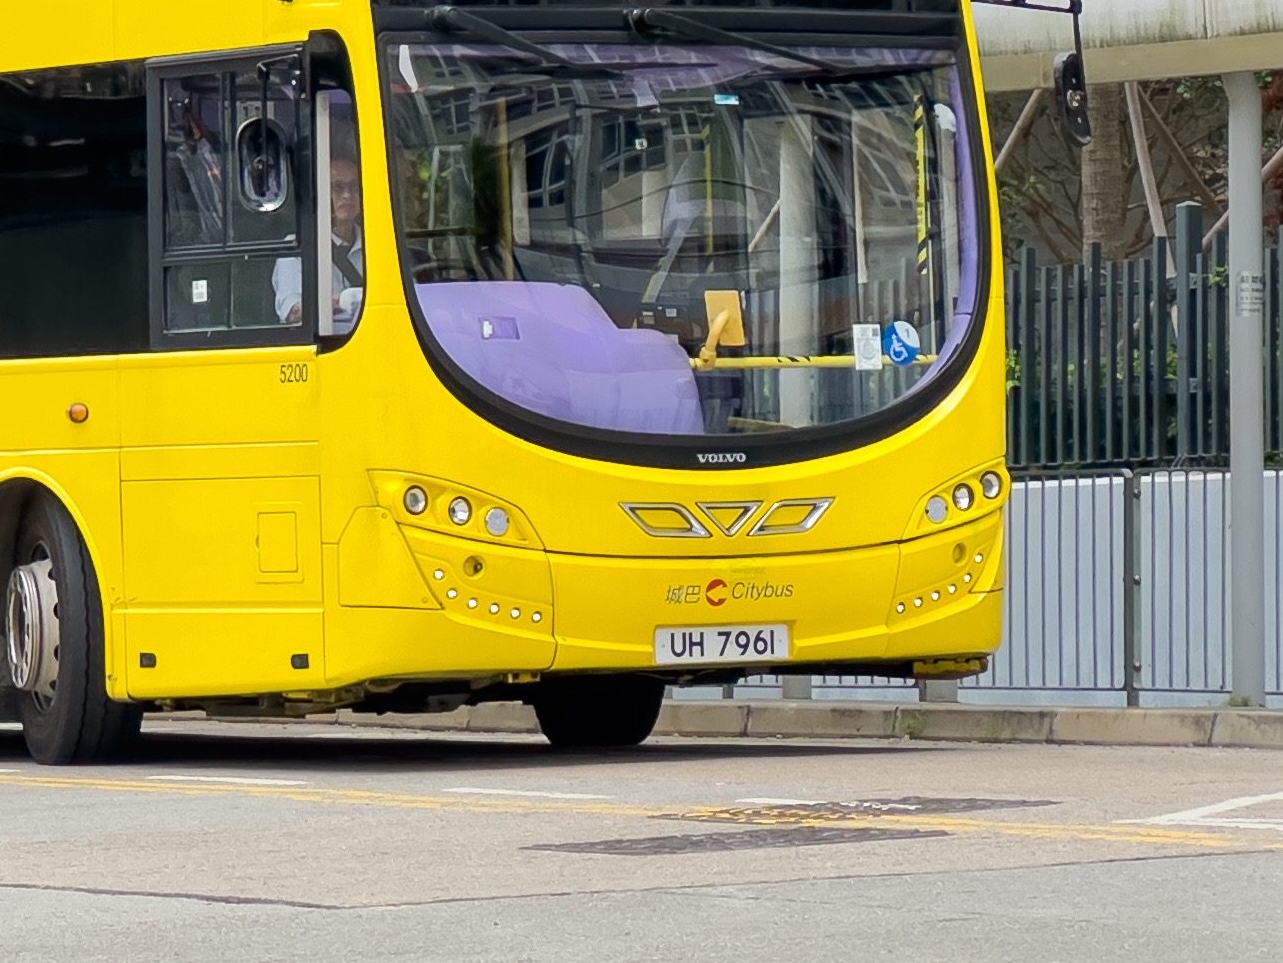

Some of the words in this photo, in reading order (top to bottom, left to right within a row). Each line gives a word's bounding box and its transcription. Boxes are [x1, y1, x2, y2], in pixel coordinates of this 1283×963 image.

[279, 364, 308, 383] 5200
[697, 453, 747, 463] VOLVO
[665, 584, 701, 604] 城巴
[731, 581, 794, 601] Citybus
[670, 632, 705, 658] UH
[717, 630, 775, 656] 7961
